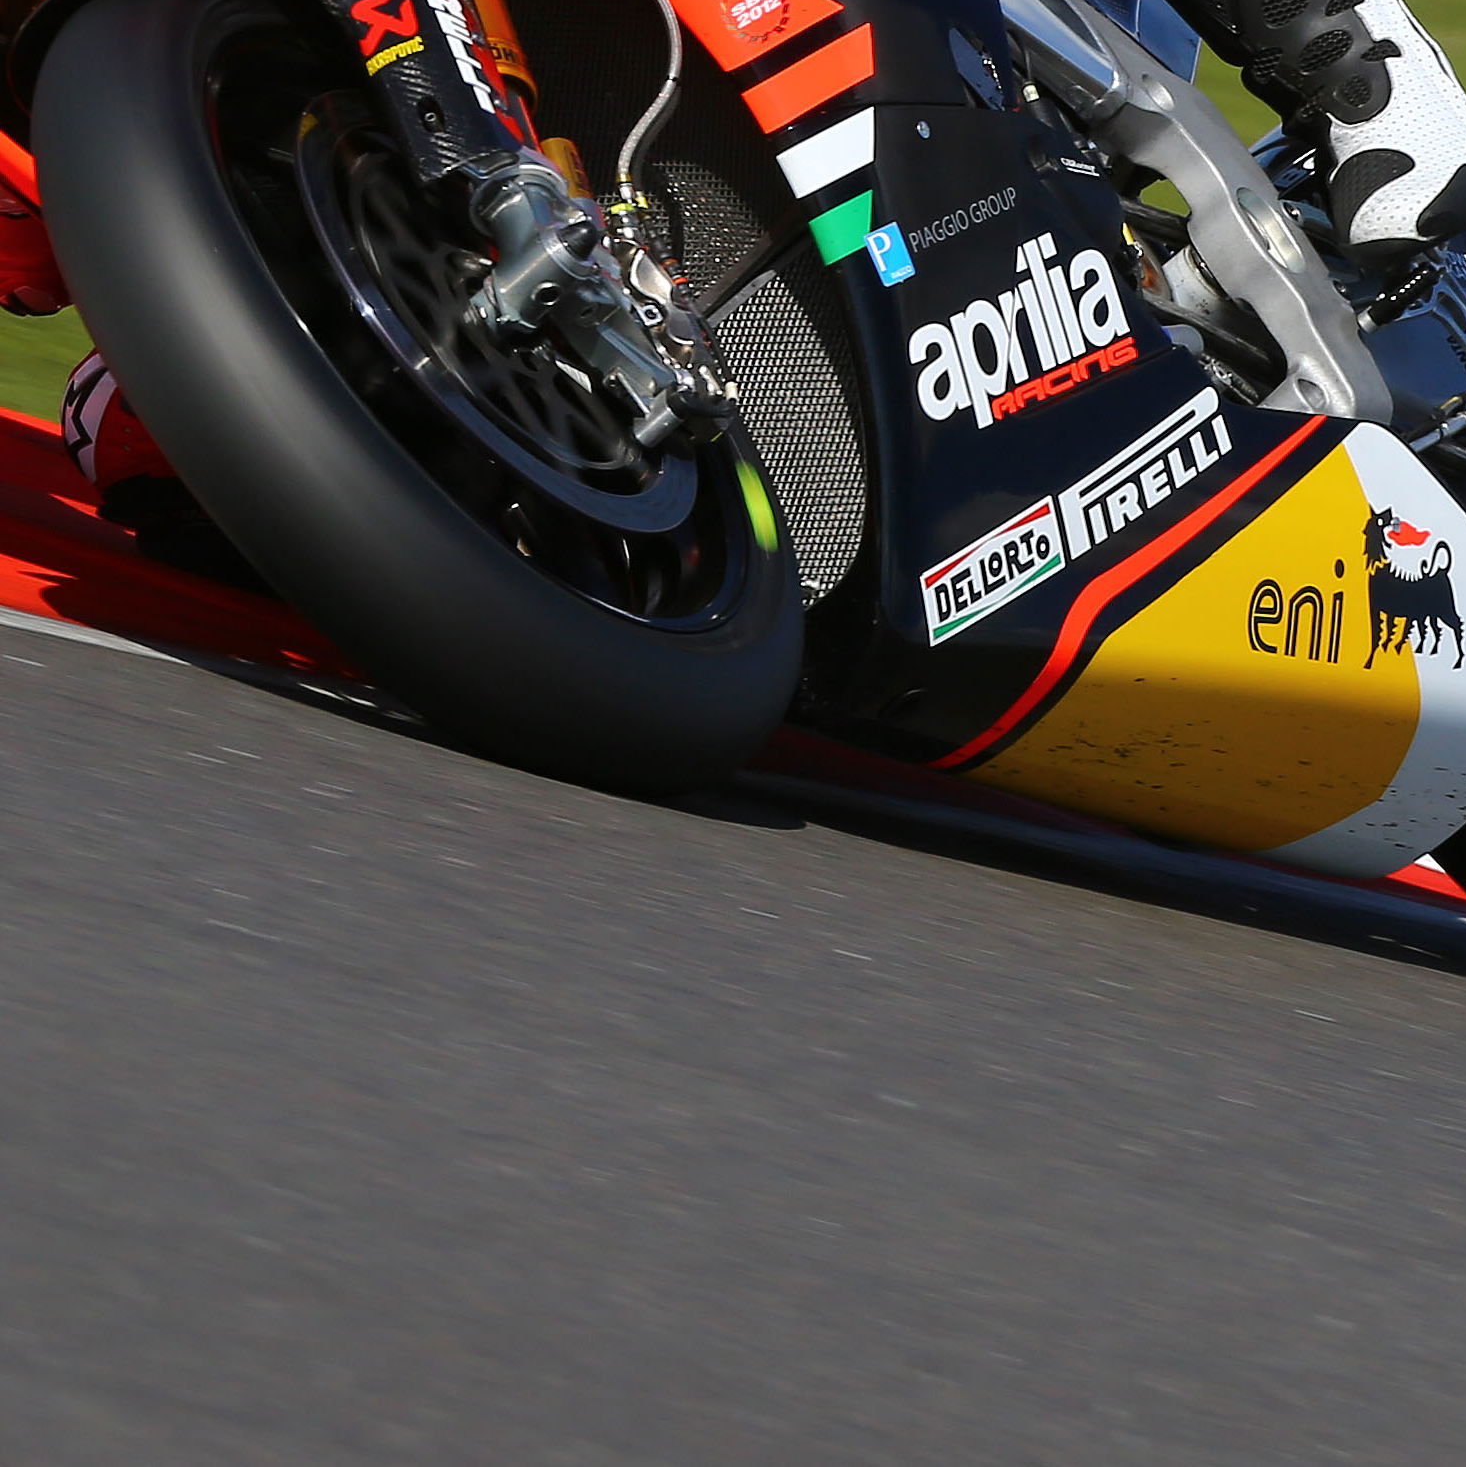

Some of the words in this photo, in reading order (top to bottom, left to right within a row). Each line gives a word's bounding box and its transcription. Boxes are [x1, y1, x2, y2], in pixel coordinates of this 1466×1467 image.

[908, 210, 969, 253] PIAGGIO
[969, 186, 1017, 224] GROUP
[908, 232, 1132, 430] aprilia
[991, 336, 1139, 421] RACING
[1057, 386, 1233, 561] PIRELLI
[1247, 558, 1345, 664] eni
